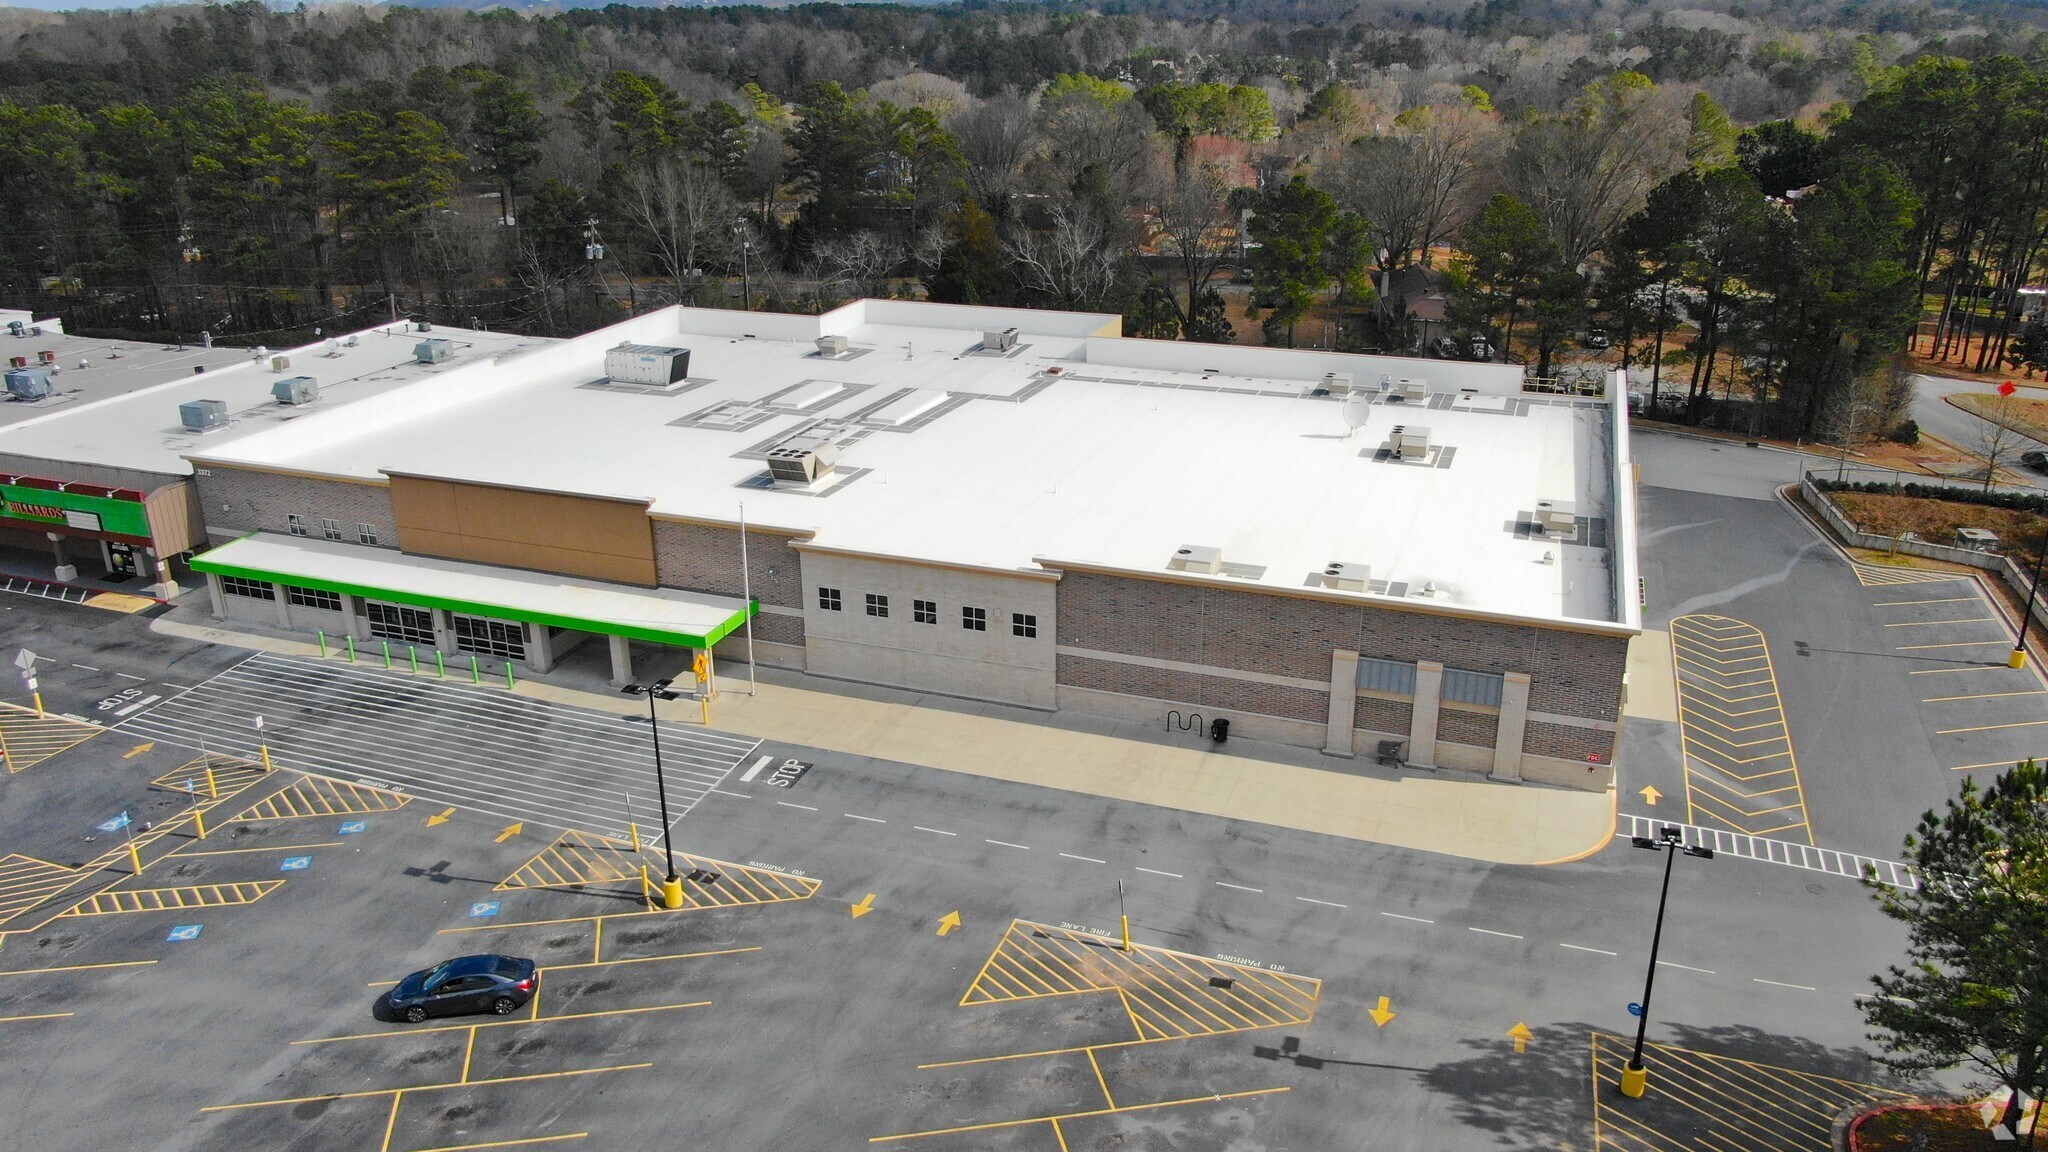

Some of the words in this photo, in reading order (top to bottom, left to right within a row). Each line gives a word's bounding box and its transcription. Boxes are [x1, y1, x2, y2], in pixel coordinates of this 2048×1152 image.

[9, 501, 64, 520] BILLIARDS
[98, 688, 143, 710] STOP
[767, 759, 805, 787] STOP
[606, 831, 630, 840] LANE
[748, 860, 786, 873] PARKING
[1059, 921, 1086, 931] LANE
[1089, 927, 1111, 937] FIRE
[1216, 953, 1261, 967] PARKING
[1270, 963, 1285, 971] NO
